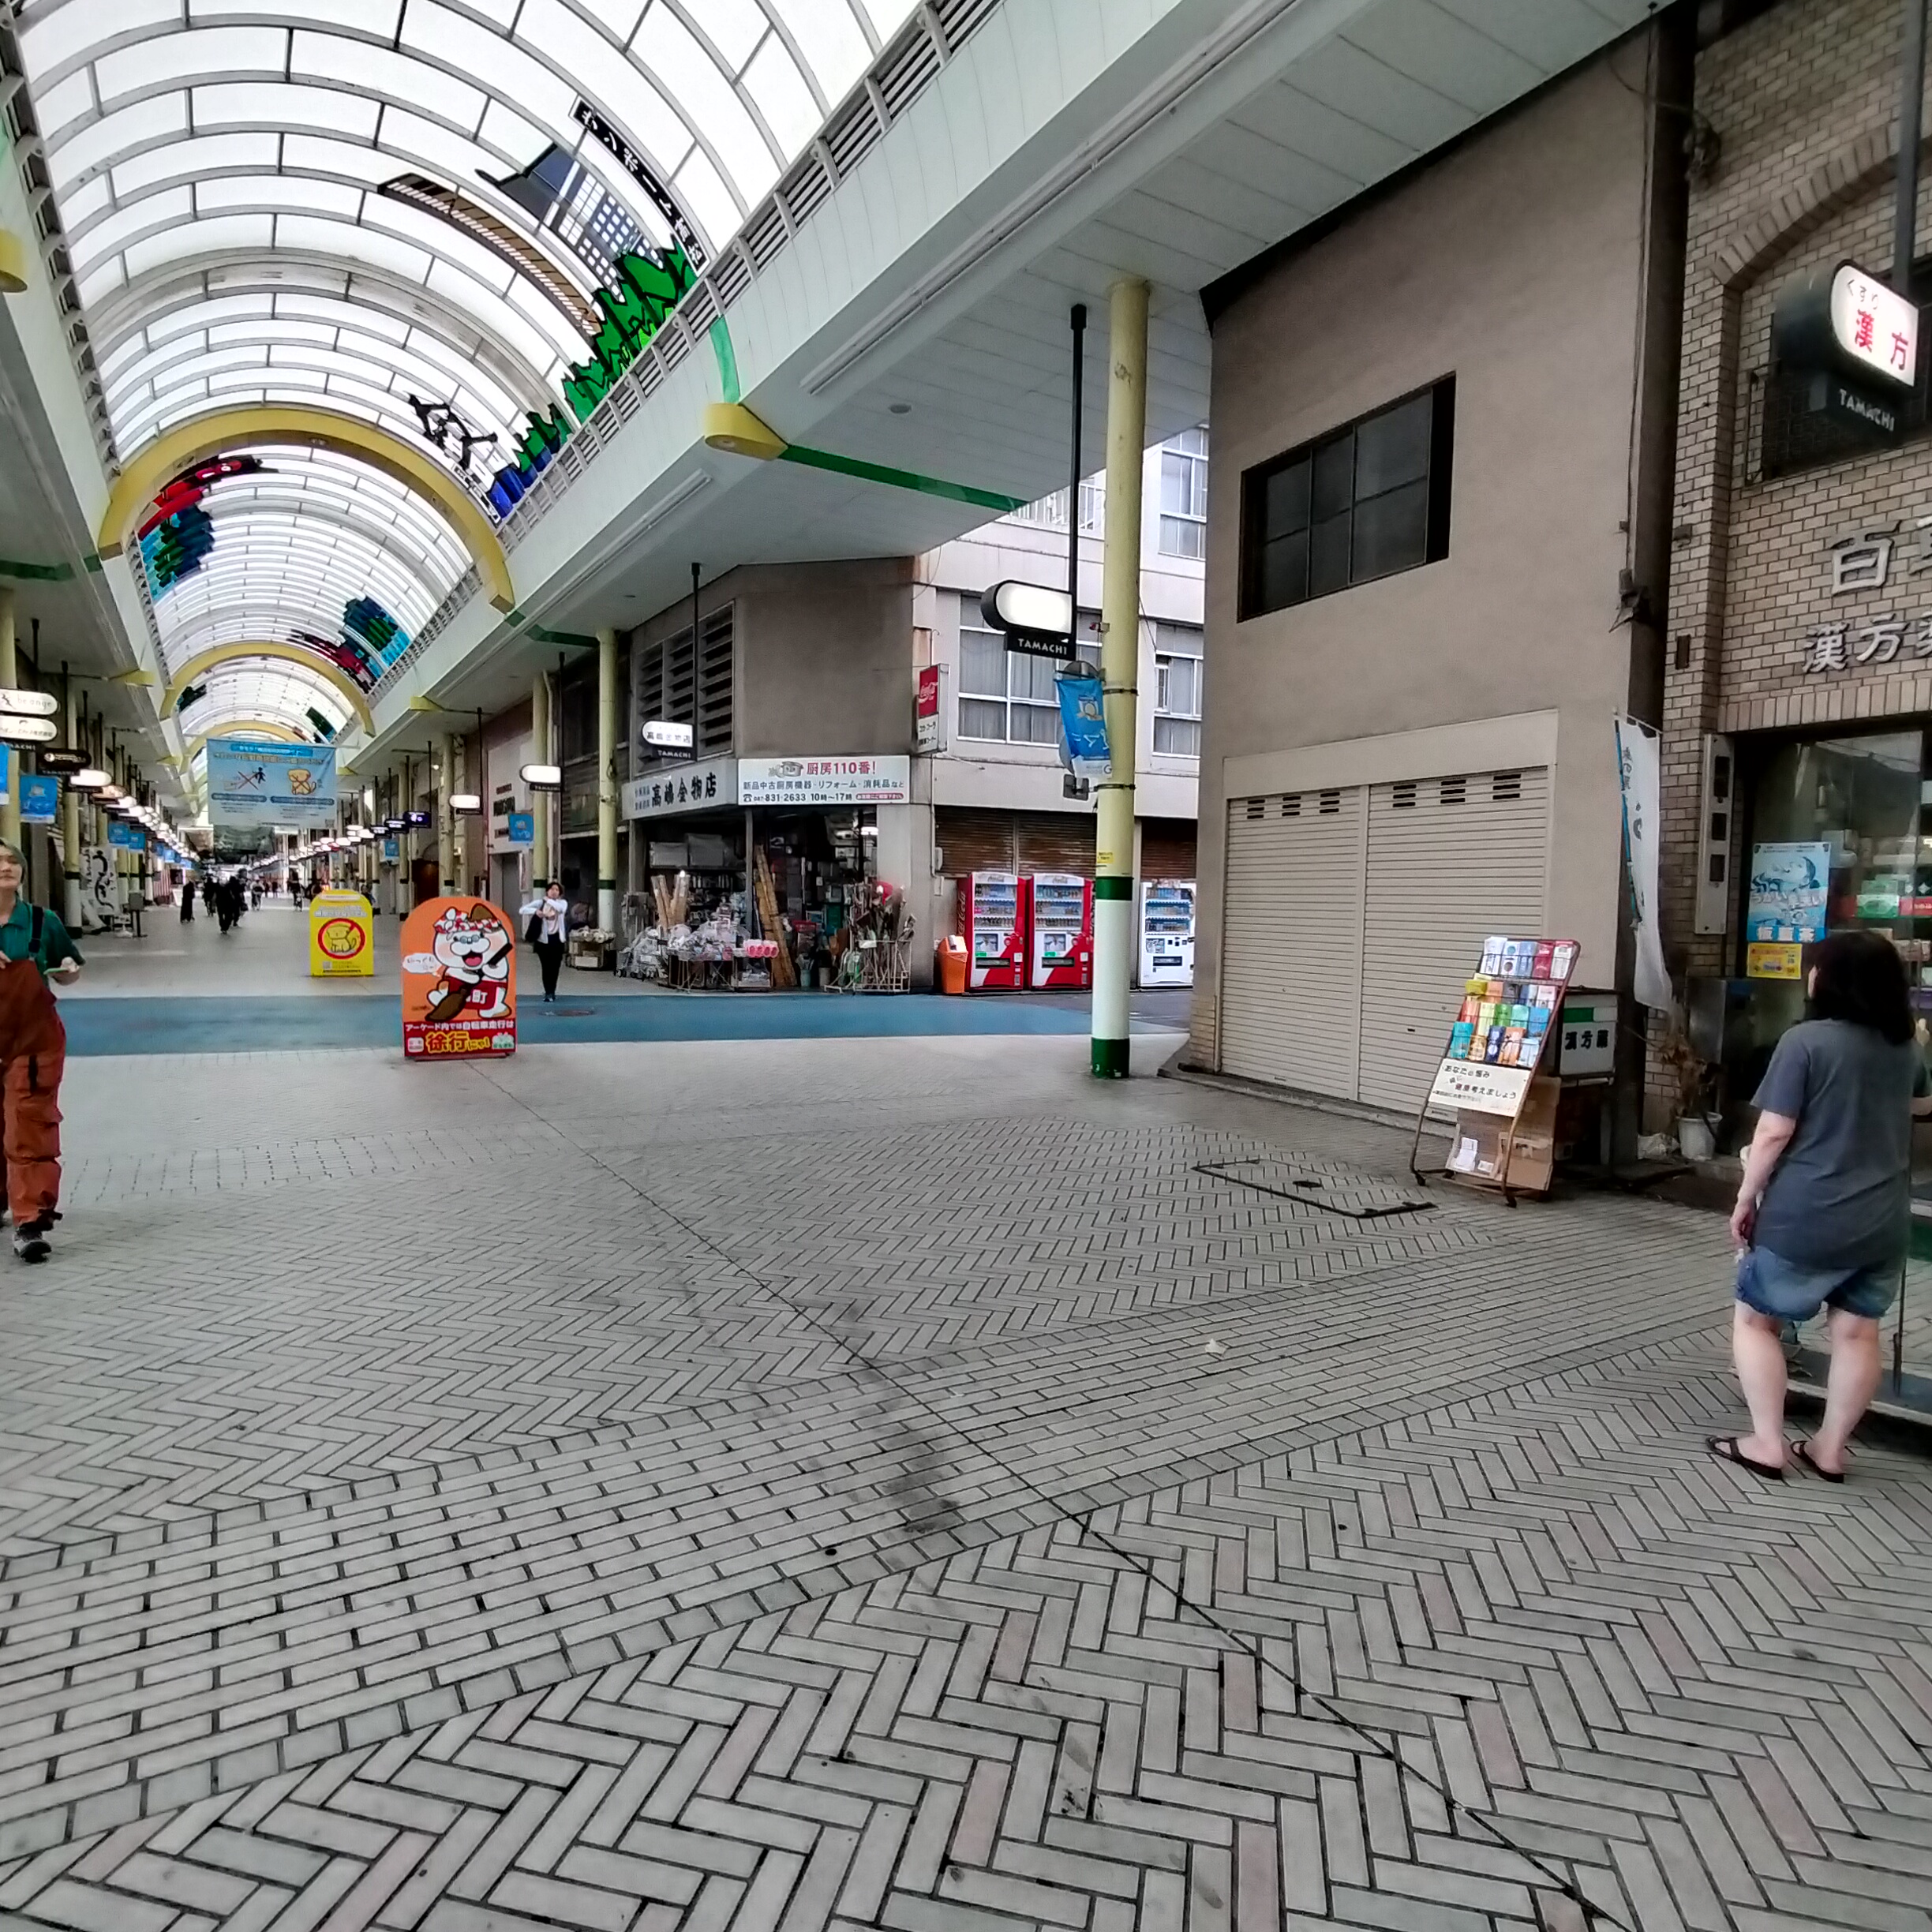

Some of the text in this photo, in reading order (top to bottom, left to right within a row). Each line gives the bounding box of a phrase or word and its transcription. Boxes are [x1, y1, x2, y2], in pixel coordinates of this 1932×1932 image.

[1848, 279, 1878, 309] くすり
[1855, 309, 1909, 371] 漢方
[1840, 388, 1895, 432] TAMACHI
[1017, 638, 1068, 655] TAMACHI
[657, 749, 691, 758] TAMACHI
